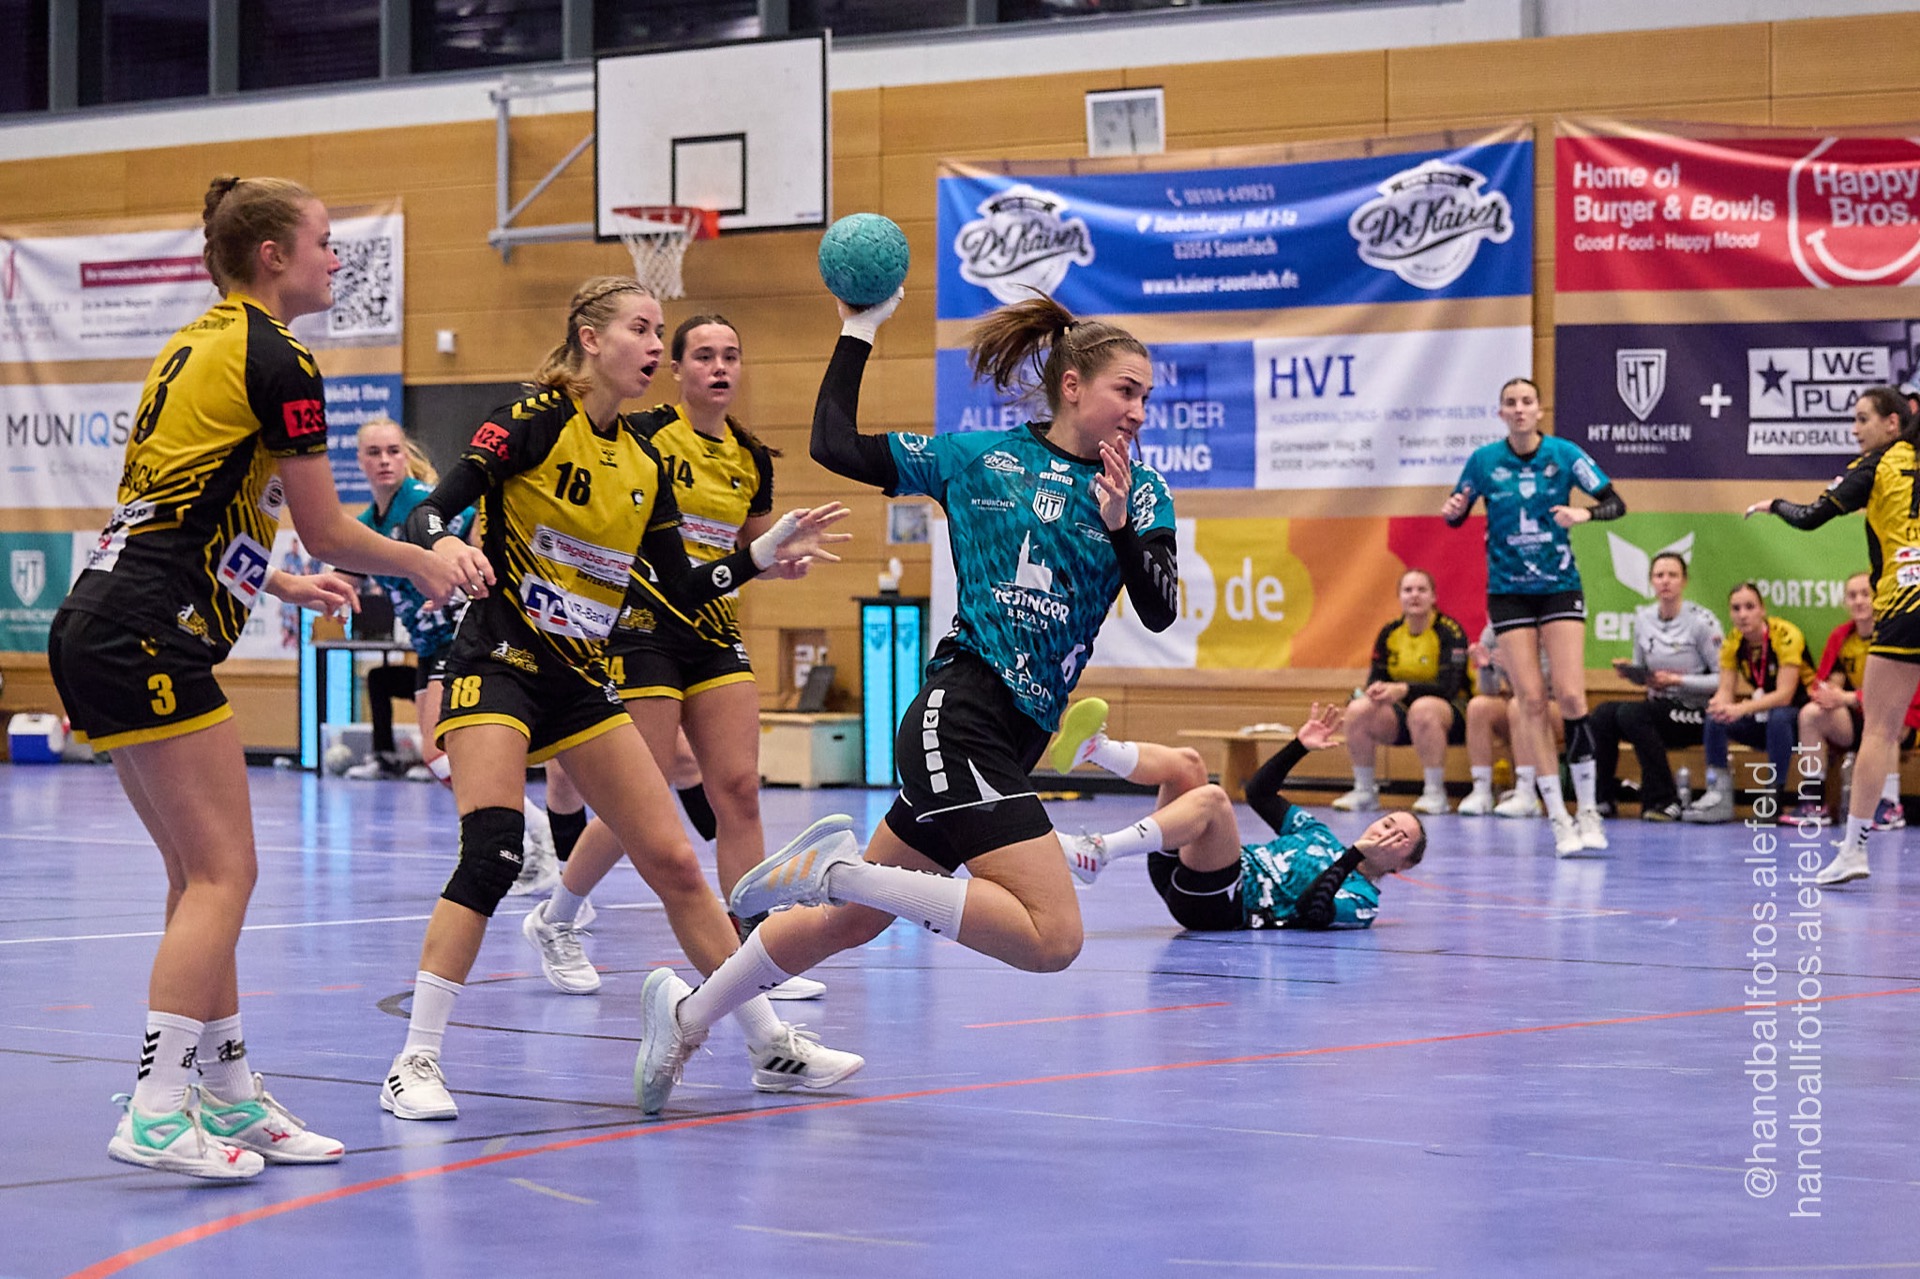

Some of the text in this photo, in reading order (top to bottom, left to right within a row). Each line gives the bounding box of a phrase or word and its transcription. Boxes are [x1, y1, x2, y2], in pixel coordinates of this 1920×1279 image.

[1573, 162, 1649, 188] Home
[1812, 164, 1920, 200] Happy
[1573, 195, 1777, 228] Burger & Bowls
[1830, 196, 1919, 228] Bros.
[1213, 235, 1278, 258] Sauerlach
[1573, 234, 1615, 251] Good
[1617, 234, 1655, 251] Food
[1665, 234, 1711, 253] Happy
[1714, 232, 1761, 250] Mood
[1142, 268, 1299, 294] www.kaiser-sauerlach.de
[1269, 354, 1356, 398] HVI
[1823, 352, 1875, 377] WE
[1173, 402, 1225, 428] DER
[1805, 390, 1860, 413] PLA
[6, 409, 130, 447] MUNIQS
[1587, 423, 1692, 442] HT MÜNCHEN
[664, 455, 694, 489] 14
[1140, 444, 1212, 473] TUNG
[554, 461, 592, 506] 18
[1039, 471, 1074, 487] erima
[1038, 497, 1060, 520] HT
[147, 673, 177, 716] 3
[450, 674, 482, 710] 18
